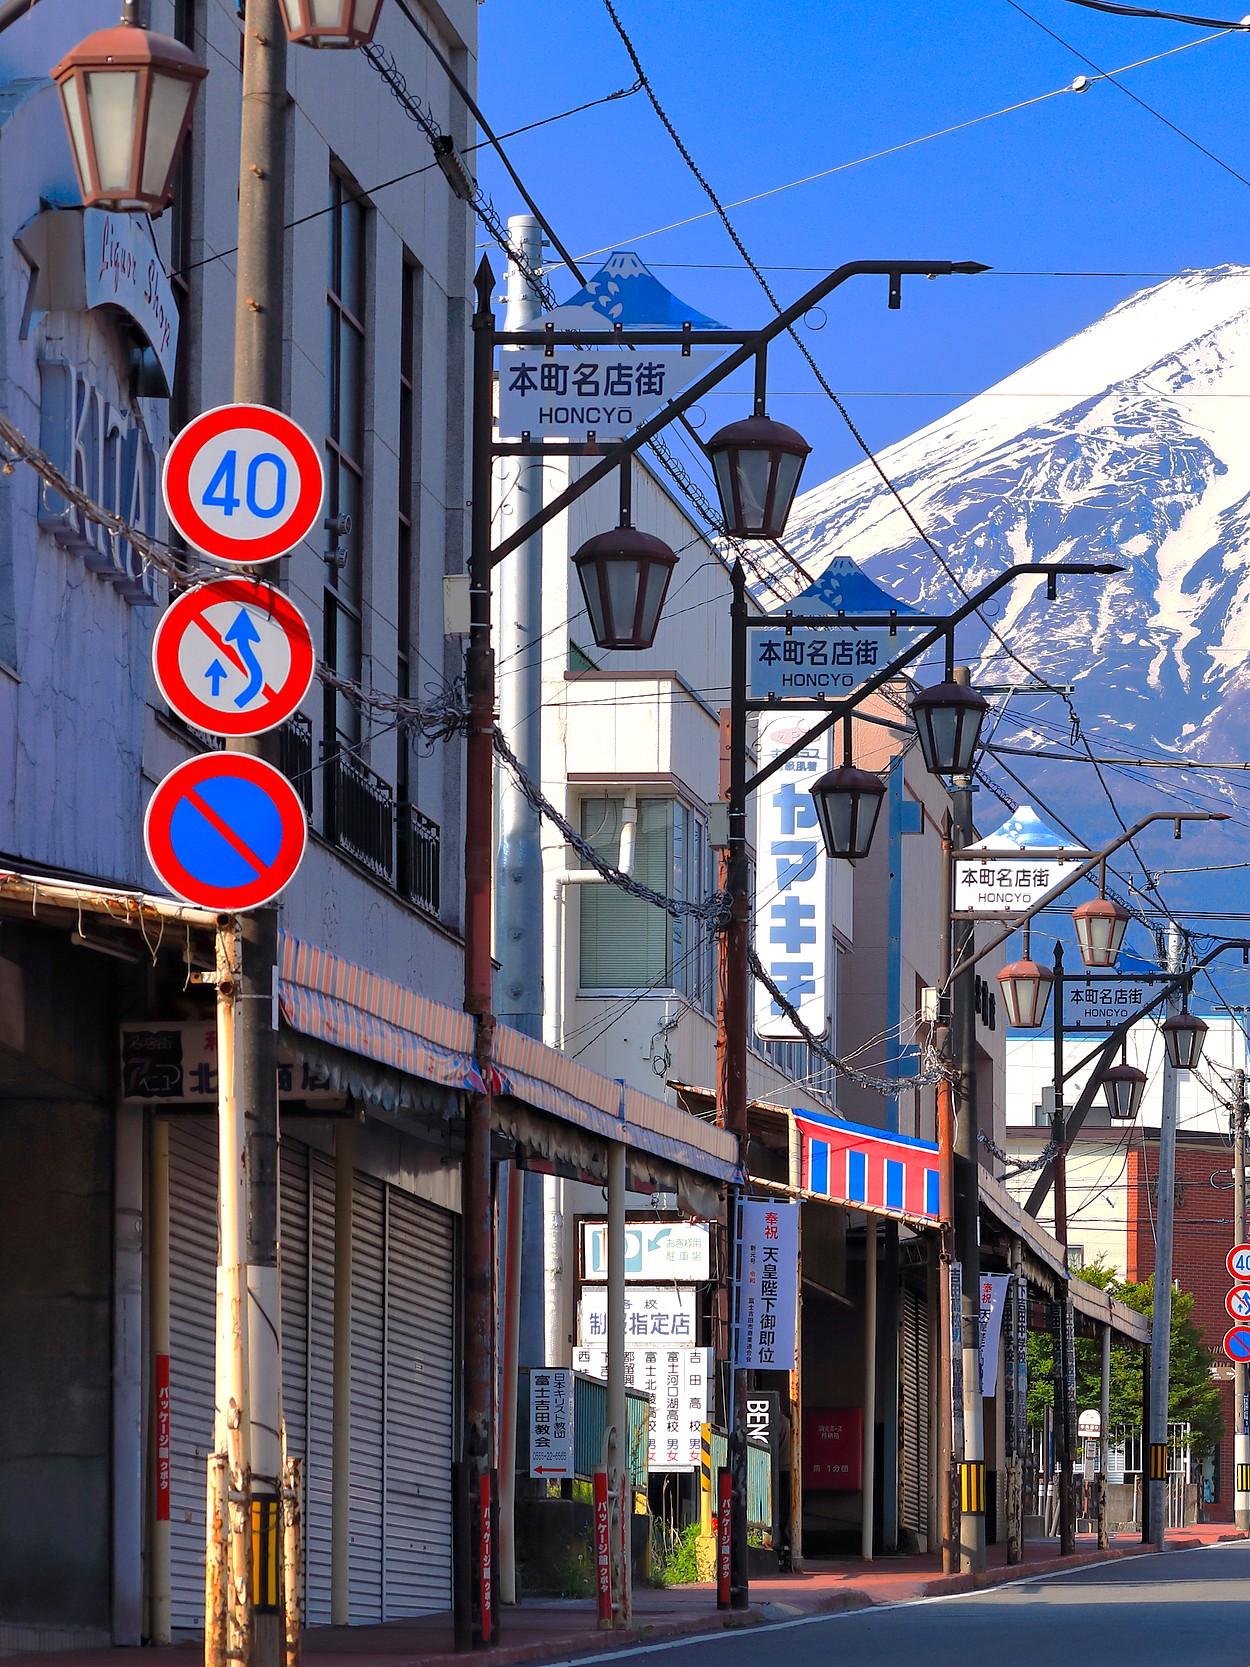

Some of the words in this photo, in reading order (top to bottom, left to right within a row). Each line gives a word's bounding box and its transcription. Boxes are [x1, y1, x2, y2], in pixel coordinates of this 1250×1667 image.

[99, 216, 136, 293] Liquor
[144, 259, 171, 352] Shop
[509, 363, 665, 397] 本町名店街
[202, 450, 288, 518] 40
[759, 640, 878, 666] 本町名店街
[962, 868, 1049, 887] 本町名店街
[1071, 989, 1142, 1004] 本町名店街
[765, 1212, 778, 1239] 奉祝
[759, 1247, 779, 1363] 天皇陛下御即位
[982, 1283, 991, 1303] 奉祝
[689, 1349, 701, 1432] 吉田高校
[535, 1375, 551, 1448] 富士吉田教会
